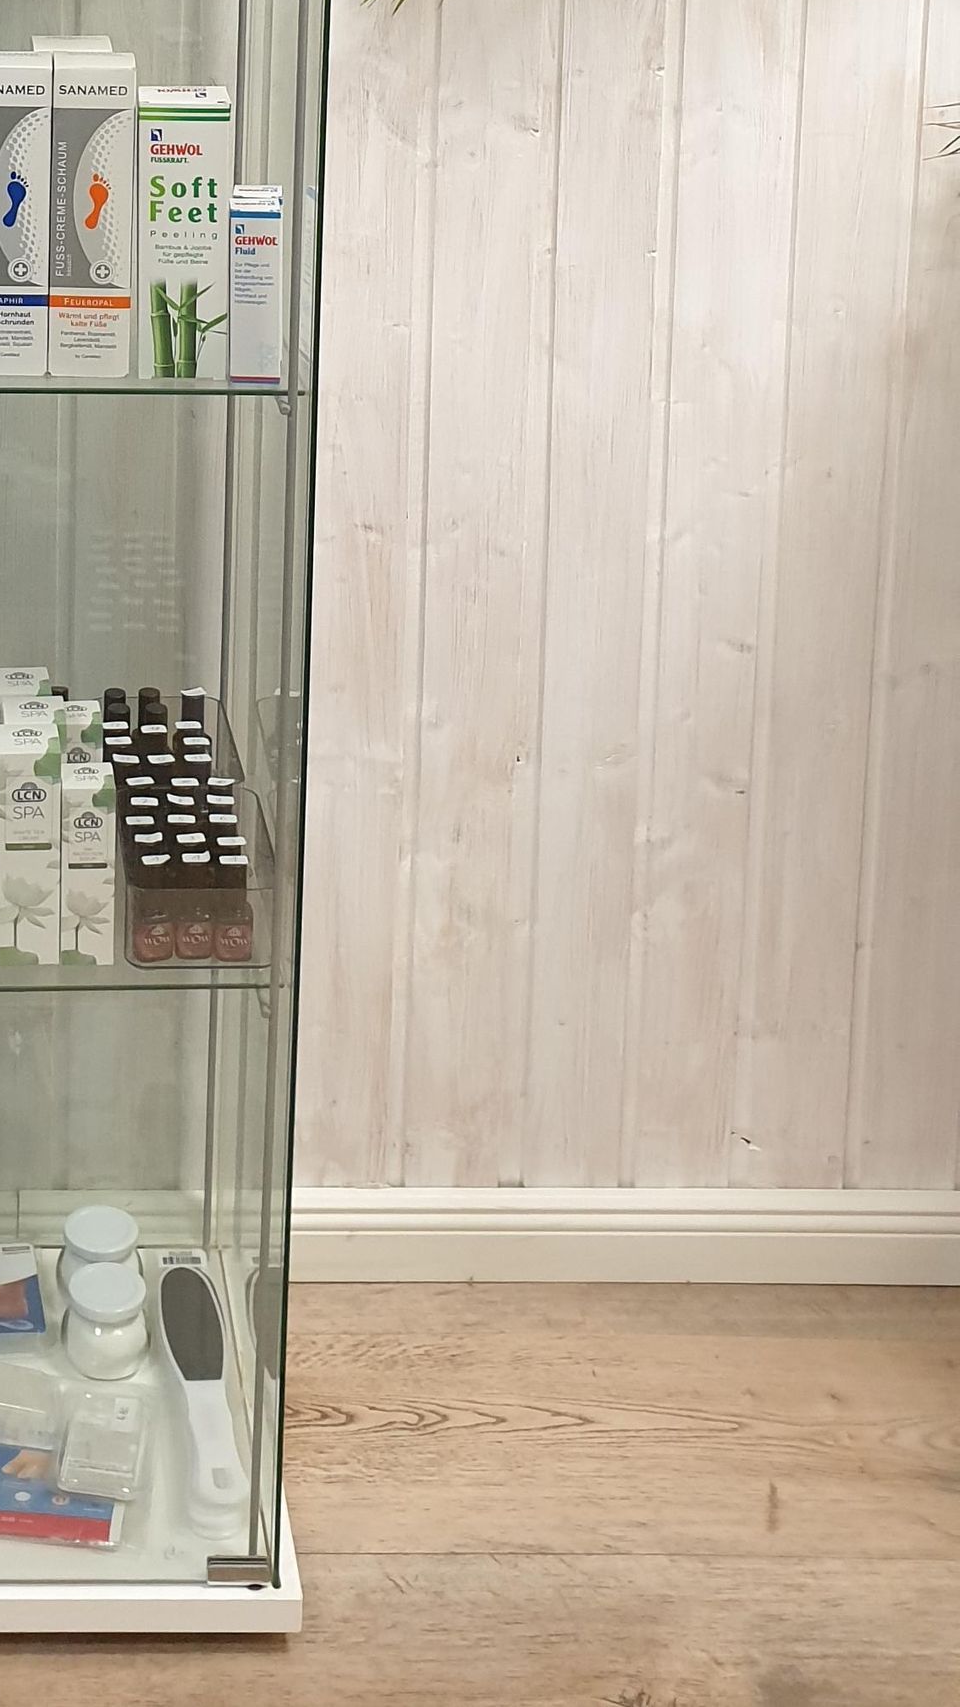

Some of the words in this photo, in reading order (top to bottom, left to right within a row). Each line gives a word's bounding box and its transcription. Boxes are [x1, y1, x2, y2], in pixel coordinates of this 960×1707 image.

[59, 85, 128, 96] SANAMED
[150, 143, 203, 156] GEHWOL
[149, 175, 218, 199] Soft
[55, 141, 67, 277] FUSS-CREME-SCHAUM
[149, 200, 218, 223] Feet
[149, 229, 218, 241] Peeling
[235, 235, 279, 247] GEHWOL
[235, 247, 256, 256] Fluid
[64, 297, 113, 307] FEUEROPAL
[83, 312, 98, 320] und
[99, 312, 119, 321] pflegt
[20, 710, 48, 718] SPA
[14, 737, 41, 746] SPA
[68, 753, 88, 763] LCN
[16, 790, 41, 801] LCN
[12, 805, 45, 821] SPA
[78, 819, 99, 827] LCN
[74, 831, 102, 843] SPA
